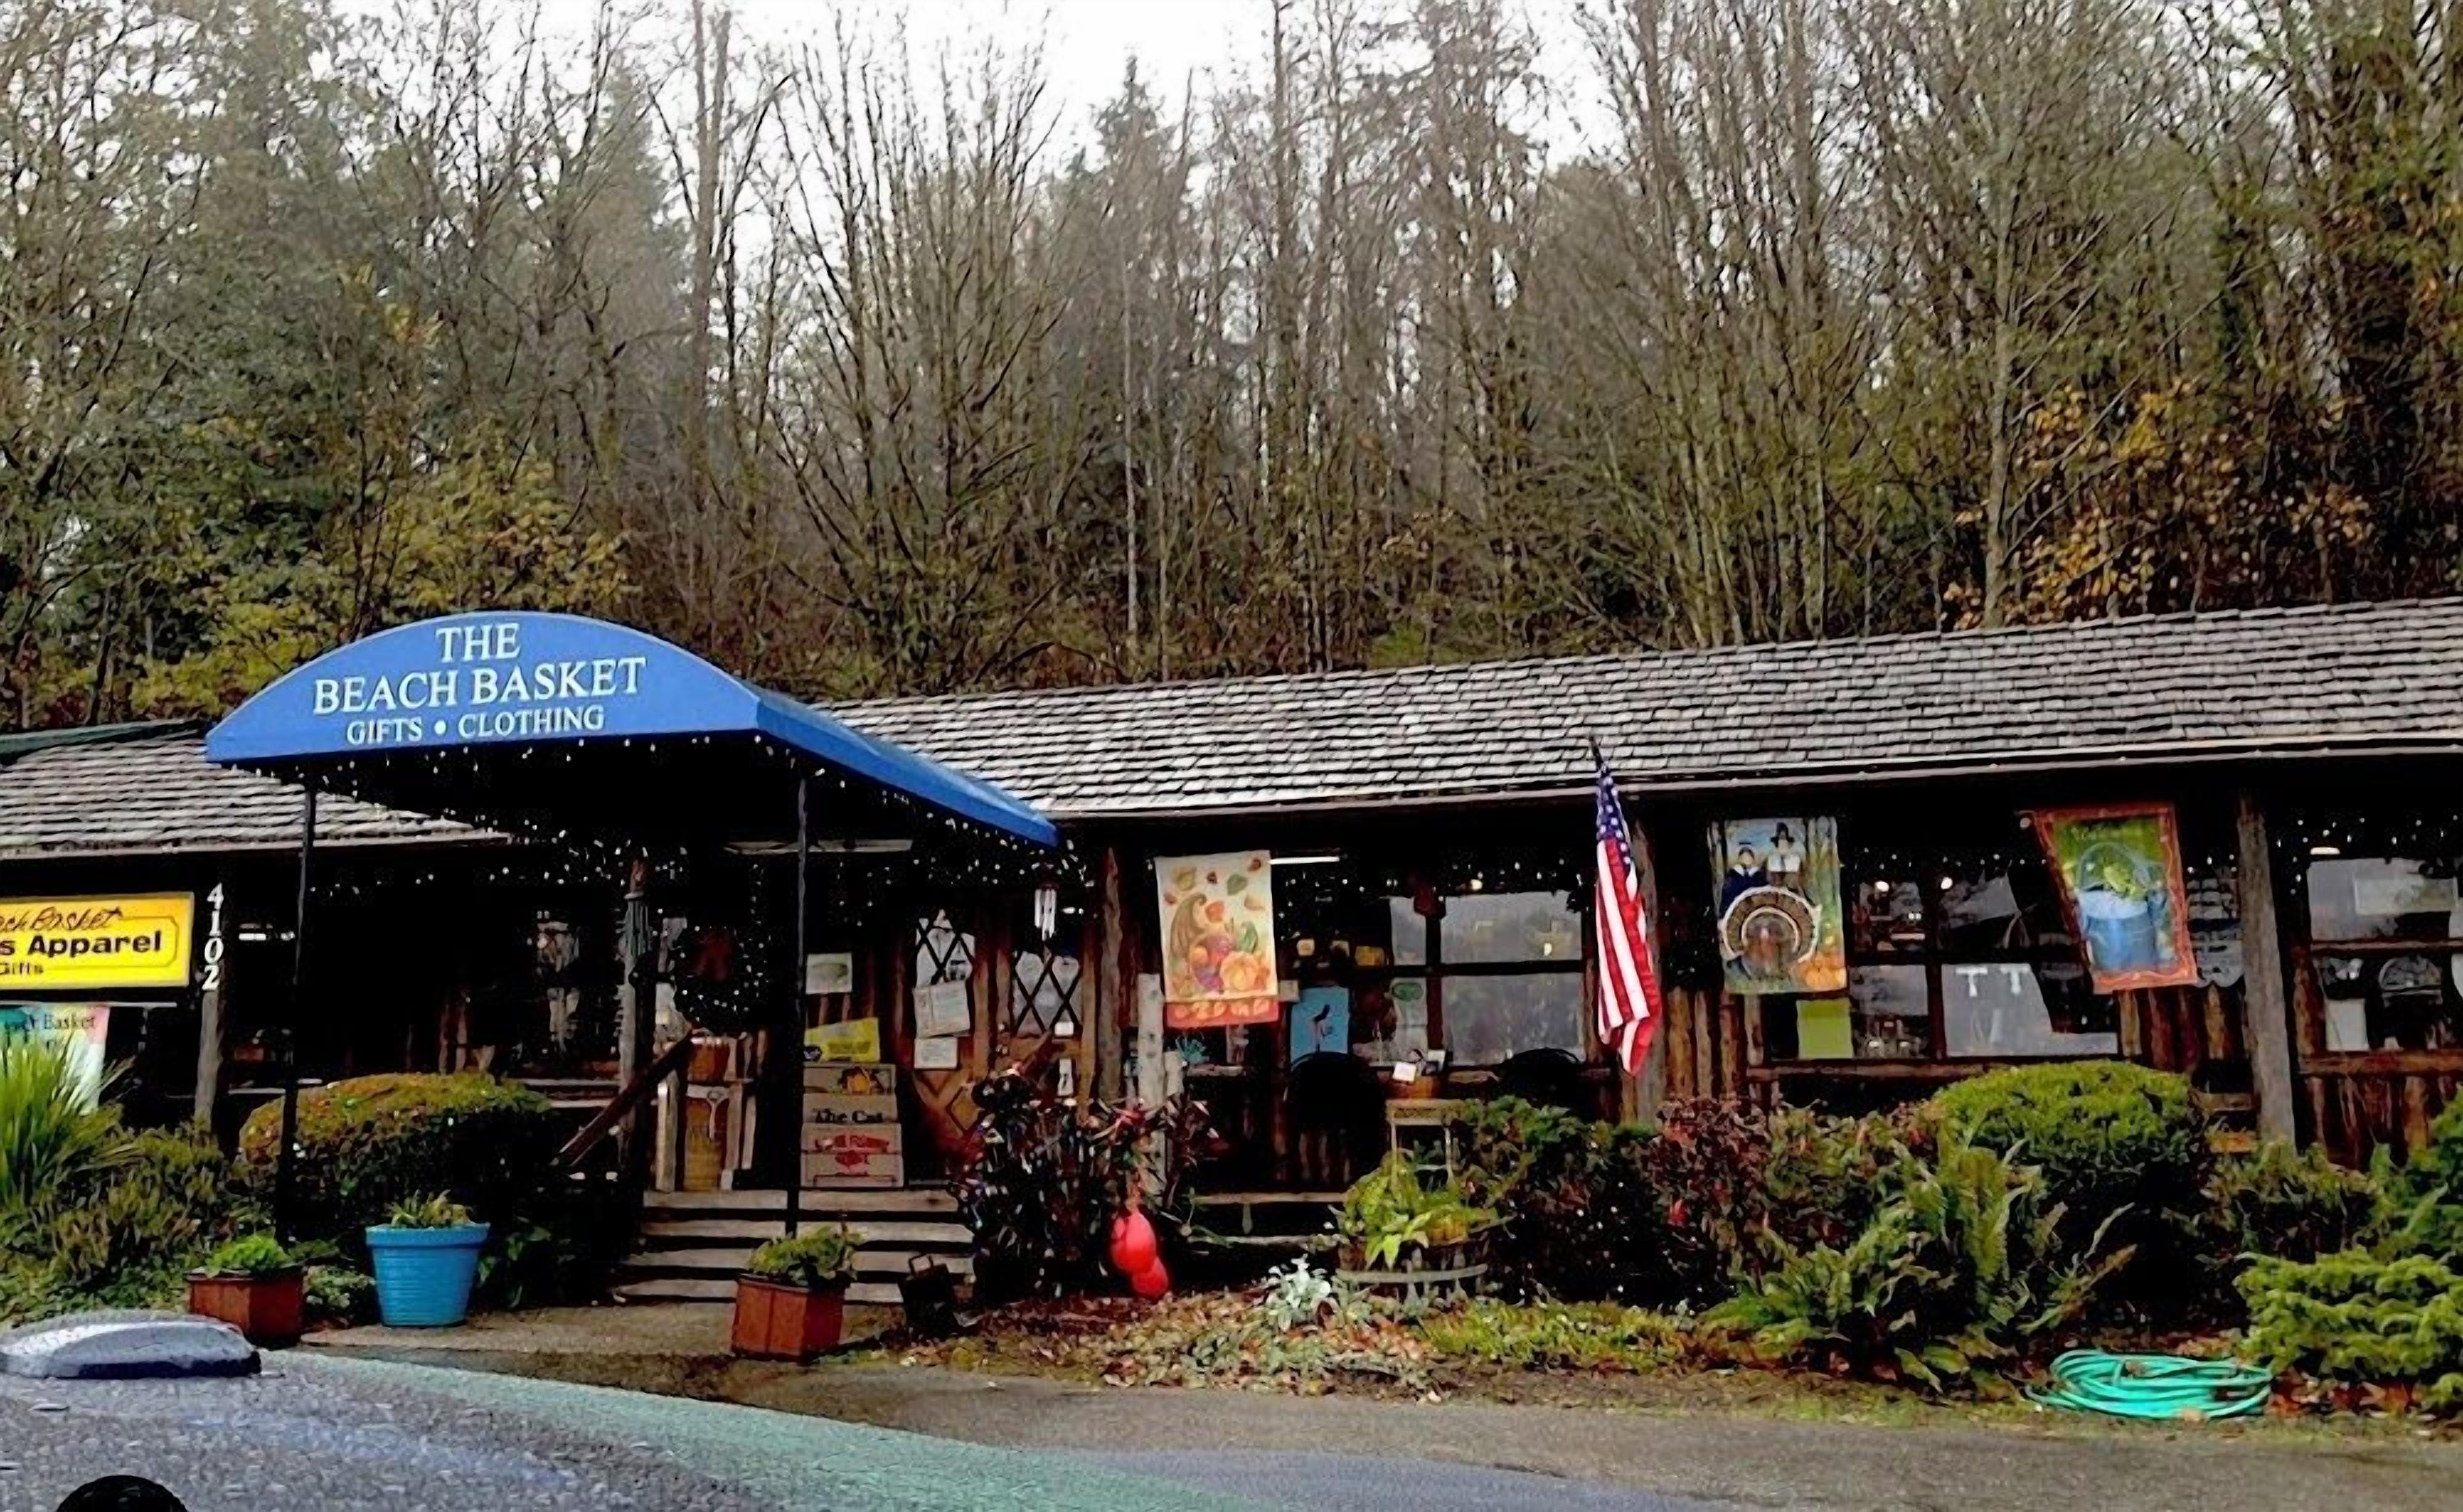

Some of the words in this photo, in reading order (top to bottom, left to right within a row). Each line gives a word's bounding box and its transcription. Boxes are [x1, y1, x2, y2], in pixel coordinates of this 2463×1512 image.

[436, 622, 520, 662] THE
[314, 670, 458, 715] BEACH
[471, 657, 646, 704] BASKET
[347, 717, 423, 745] GIFTS
[458, 705, 605, 739] CLOTHING
[27, 930, 161, 958] Apparel
[202, 883, 224, 991] 4102
